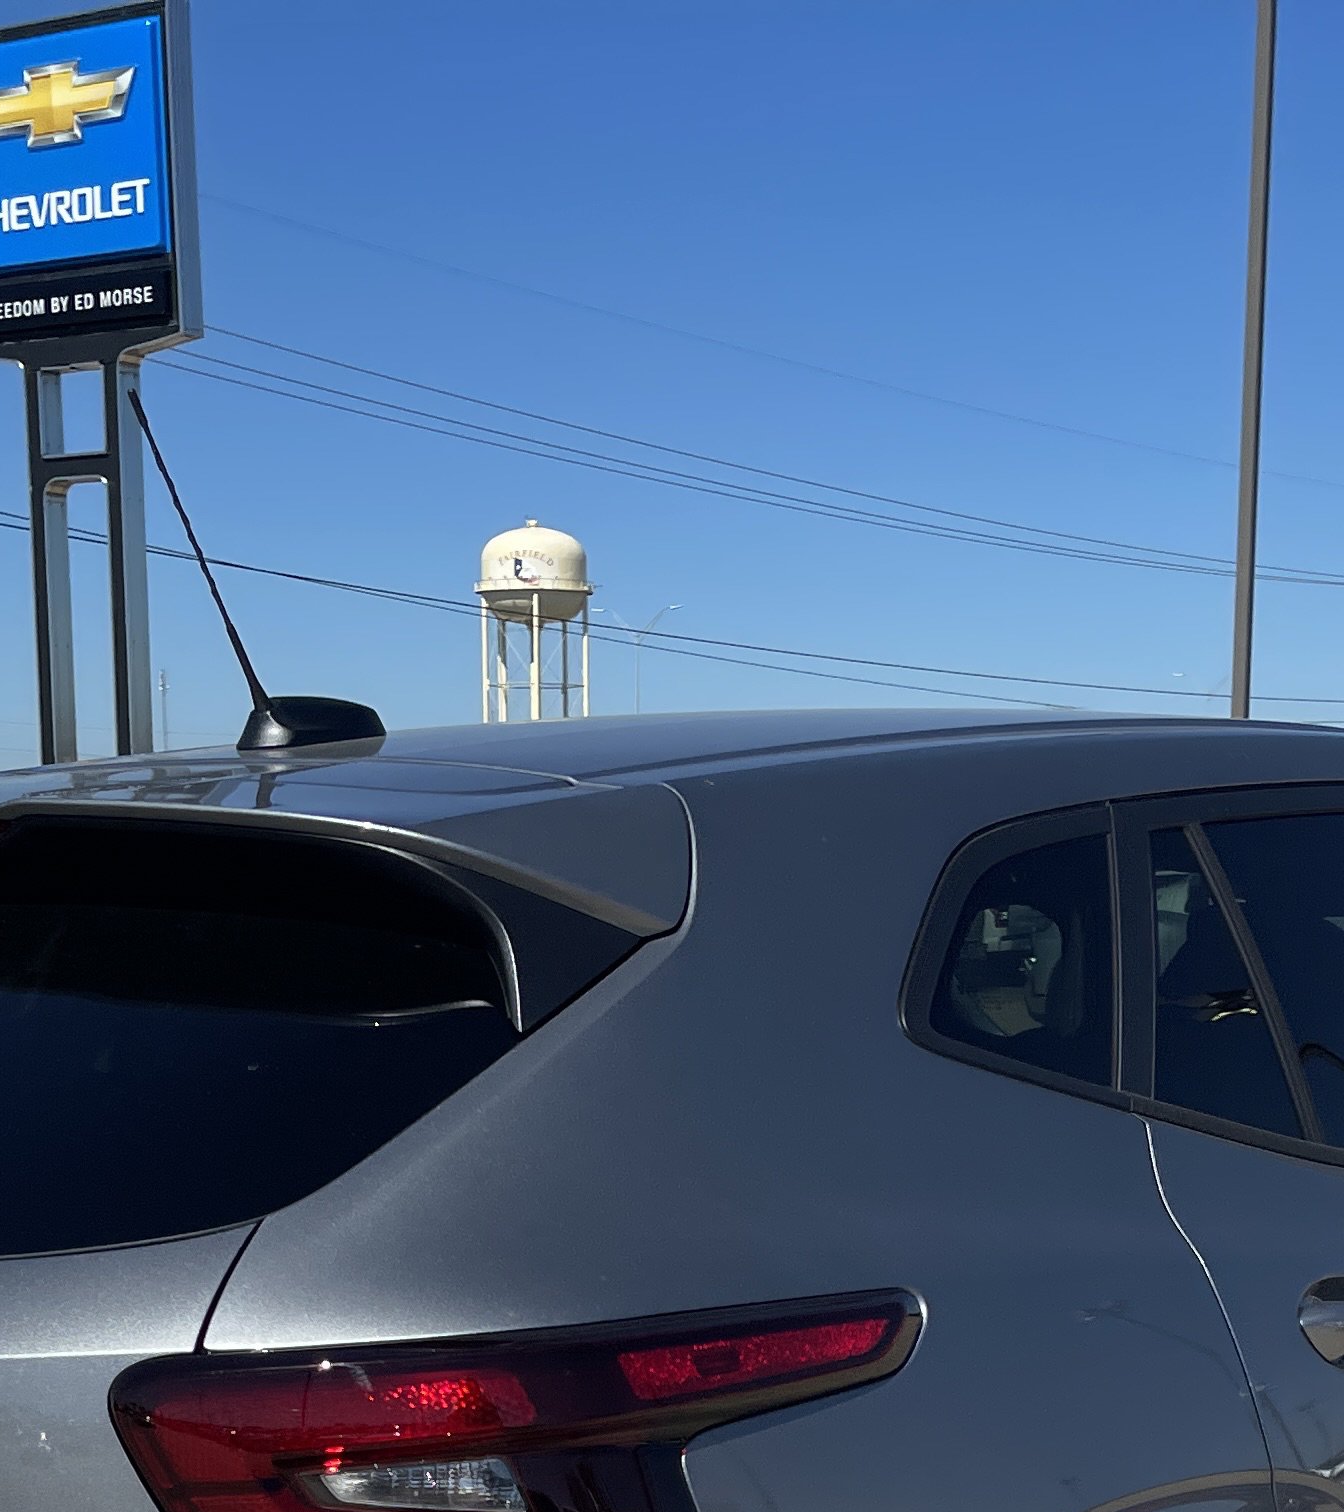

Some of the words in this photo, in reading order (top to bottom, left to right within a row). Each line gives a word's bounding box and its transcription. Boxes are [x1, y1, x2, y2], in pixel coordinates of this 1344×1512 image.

[51, 296, 68, 313] BY
[74, 291, 94, 310] ED
[100, 286, 154, 307] MORSE
[498, 549, 554, 566] FAIRFIELD
